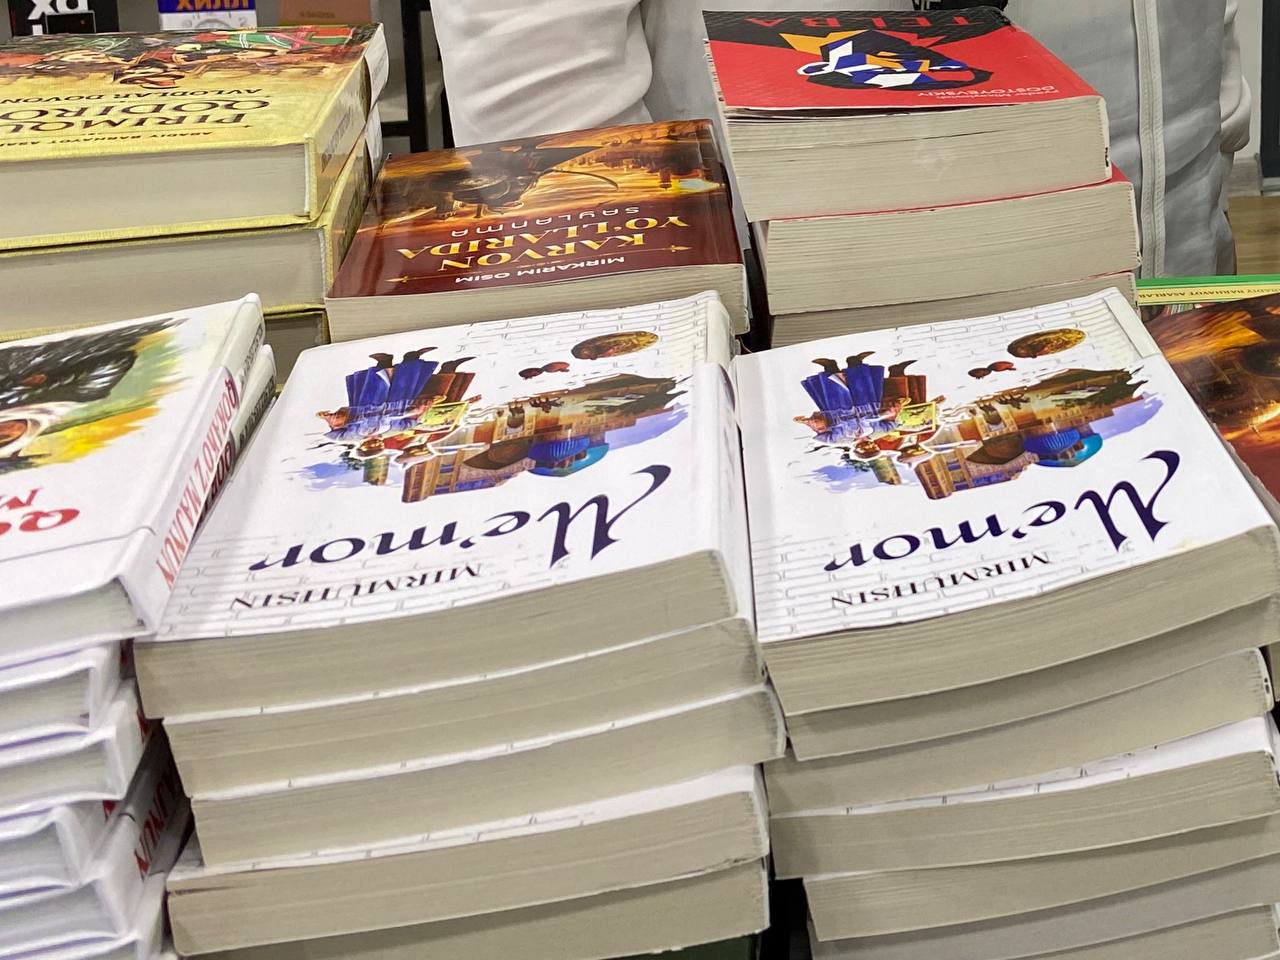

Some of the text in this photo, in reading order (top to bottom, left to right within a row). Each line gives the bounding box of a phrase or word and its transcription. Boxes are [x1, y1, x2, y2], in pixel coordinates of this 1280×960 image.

[744, 15, 971, 29] TELBA
[113, 88, 263, 100] AVLODLAR
[917, 84, 1056, 98] DOSTOYEVSKIY
[438, 231, 646, 272] KARVON
[455, 256, 626, 283] MIRKARIM OSIM
[229, 564, 479, 610] MIRMUHSIN
[830, 553, 1051, 607] MIRMUHSIN
